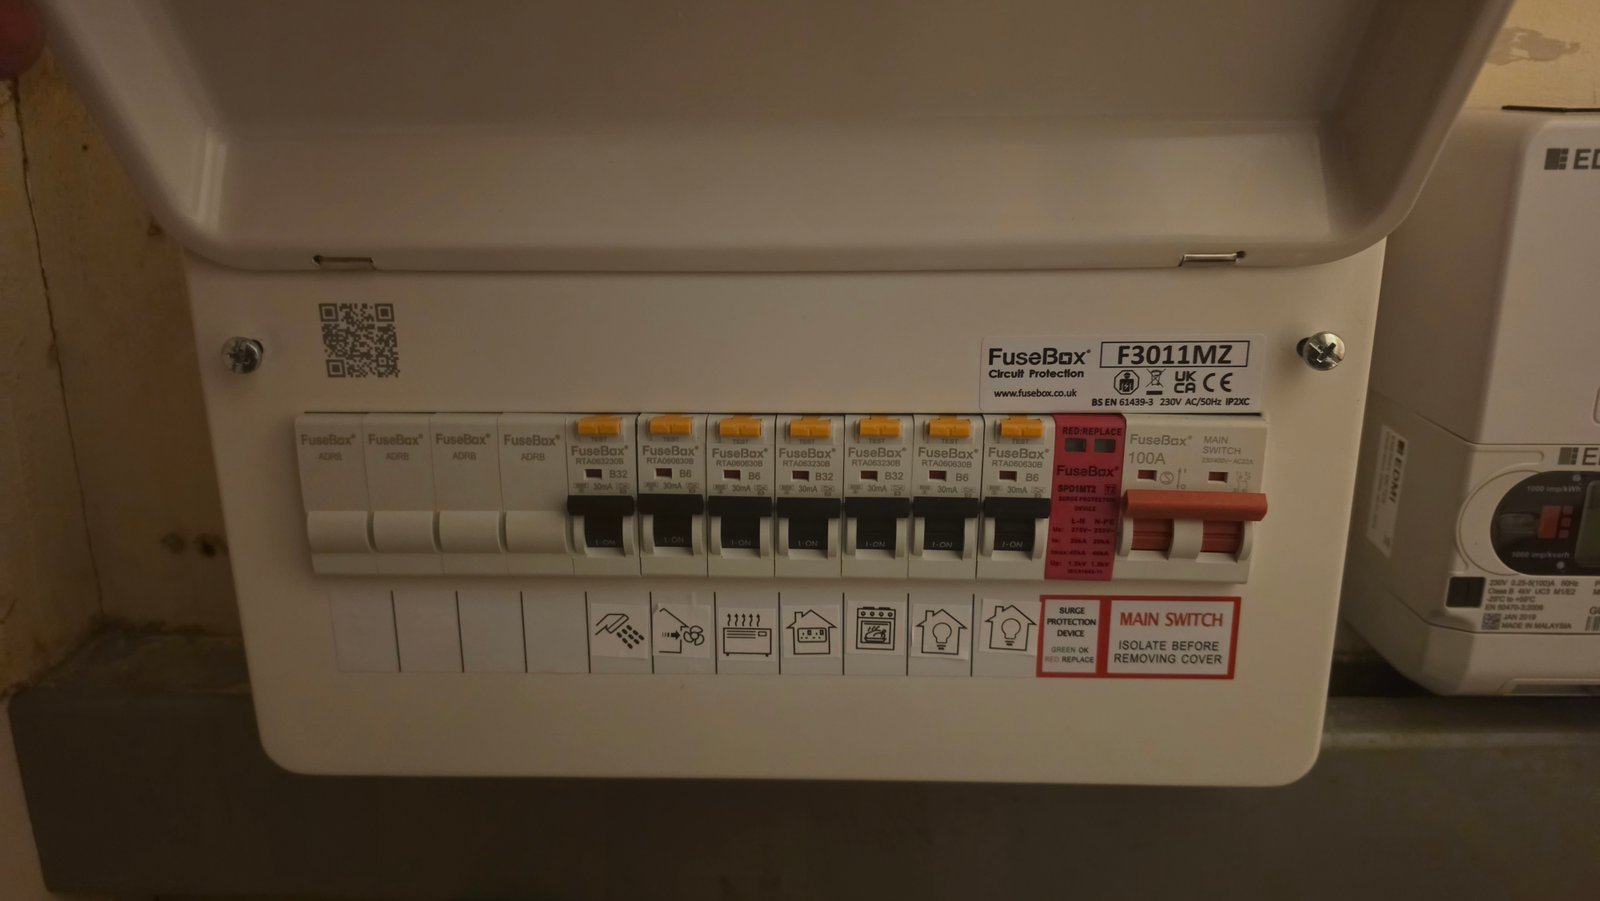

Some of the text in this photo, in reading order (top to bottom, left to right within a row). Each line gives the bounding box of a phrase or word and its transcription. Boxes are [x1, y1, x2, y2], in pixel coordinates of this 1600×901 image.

[988, 348, 1086, 366] FuseBox
[1117, 344, 1233, 364] F3011MZ
[988, 368, 1084, 379] Circuit Protection
[1174, 370, 1196, 382] UK
[994, 388, 1077, 398] www.fusebox.co.uk
[1174, 382, 1196, 394] CA
[1091, 398, 1250, 407] BS EN 61439-3 230V AC/50Hz IP2XC
[1062, 426, 1122, 436] RED:REPLACE
[300, 434, 352, 446] FuseBox
[368, 434, 419, 446] FuseBox
[435, 433, 486, 446] FuseBox
[503, 434, 556, 447] FuseBox
[1129, 433, 1187, 446] FuseBox
[1203, 436, 1228, 444] MAIN
[571, 446, 625, 456] FuseBox
[642, 446, 694, 456] FuseBox
[712, 448, 764, 459] FuseBox
[779, 448, 832, 459] FuseBox
[848, 447, 902, 458] FuseBox
[918, 447, 973, 459] FuseBox
[988, 447, 1044, 459] FuseBox
[1202, 446, 1241, 455] SWITCH
[1128, 452, 1166, 465] 100A
[1582, 448, 1600, 465] E
[609, 470, 627, 478] B32
[748, 472, 761, 480] B6
[884, 472, 904, 480] B32
[1056, 464, 1115, 477] FuseBox
[815, 473, 834, 481] B32
[956, 473, 969, 482] B6
[1026, 473, 1039, 482] B6
[1389, 458, 1402, 504] EDMI
[1047, 618, 1096, 626] PROTECTION
[1120, 612, 1223, 627] MAIN SWITCH
[1118, 640, 1219, 651] ISOLATE BEFORE
[1114, 654, 1222, 664] REMOVING COVER
